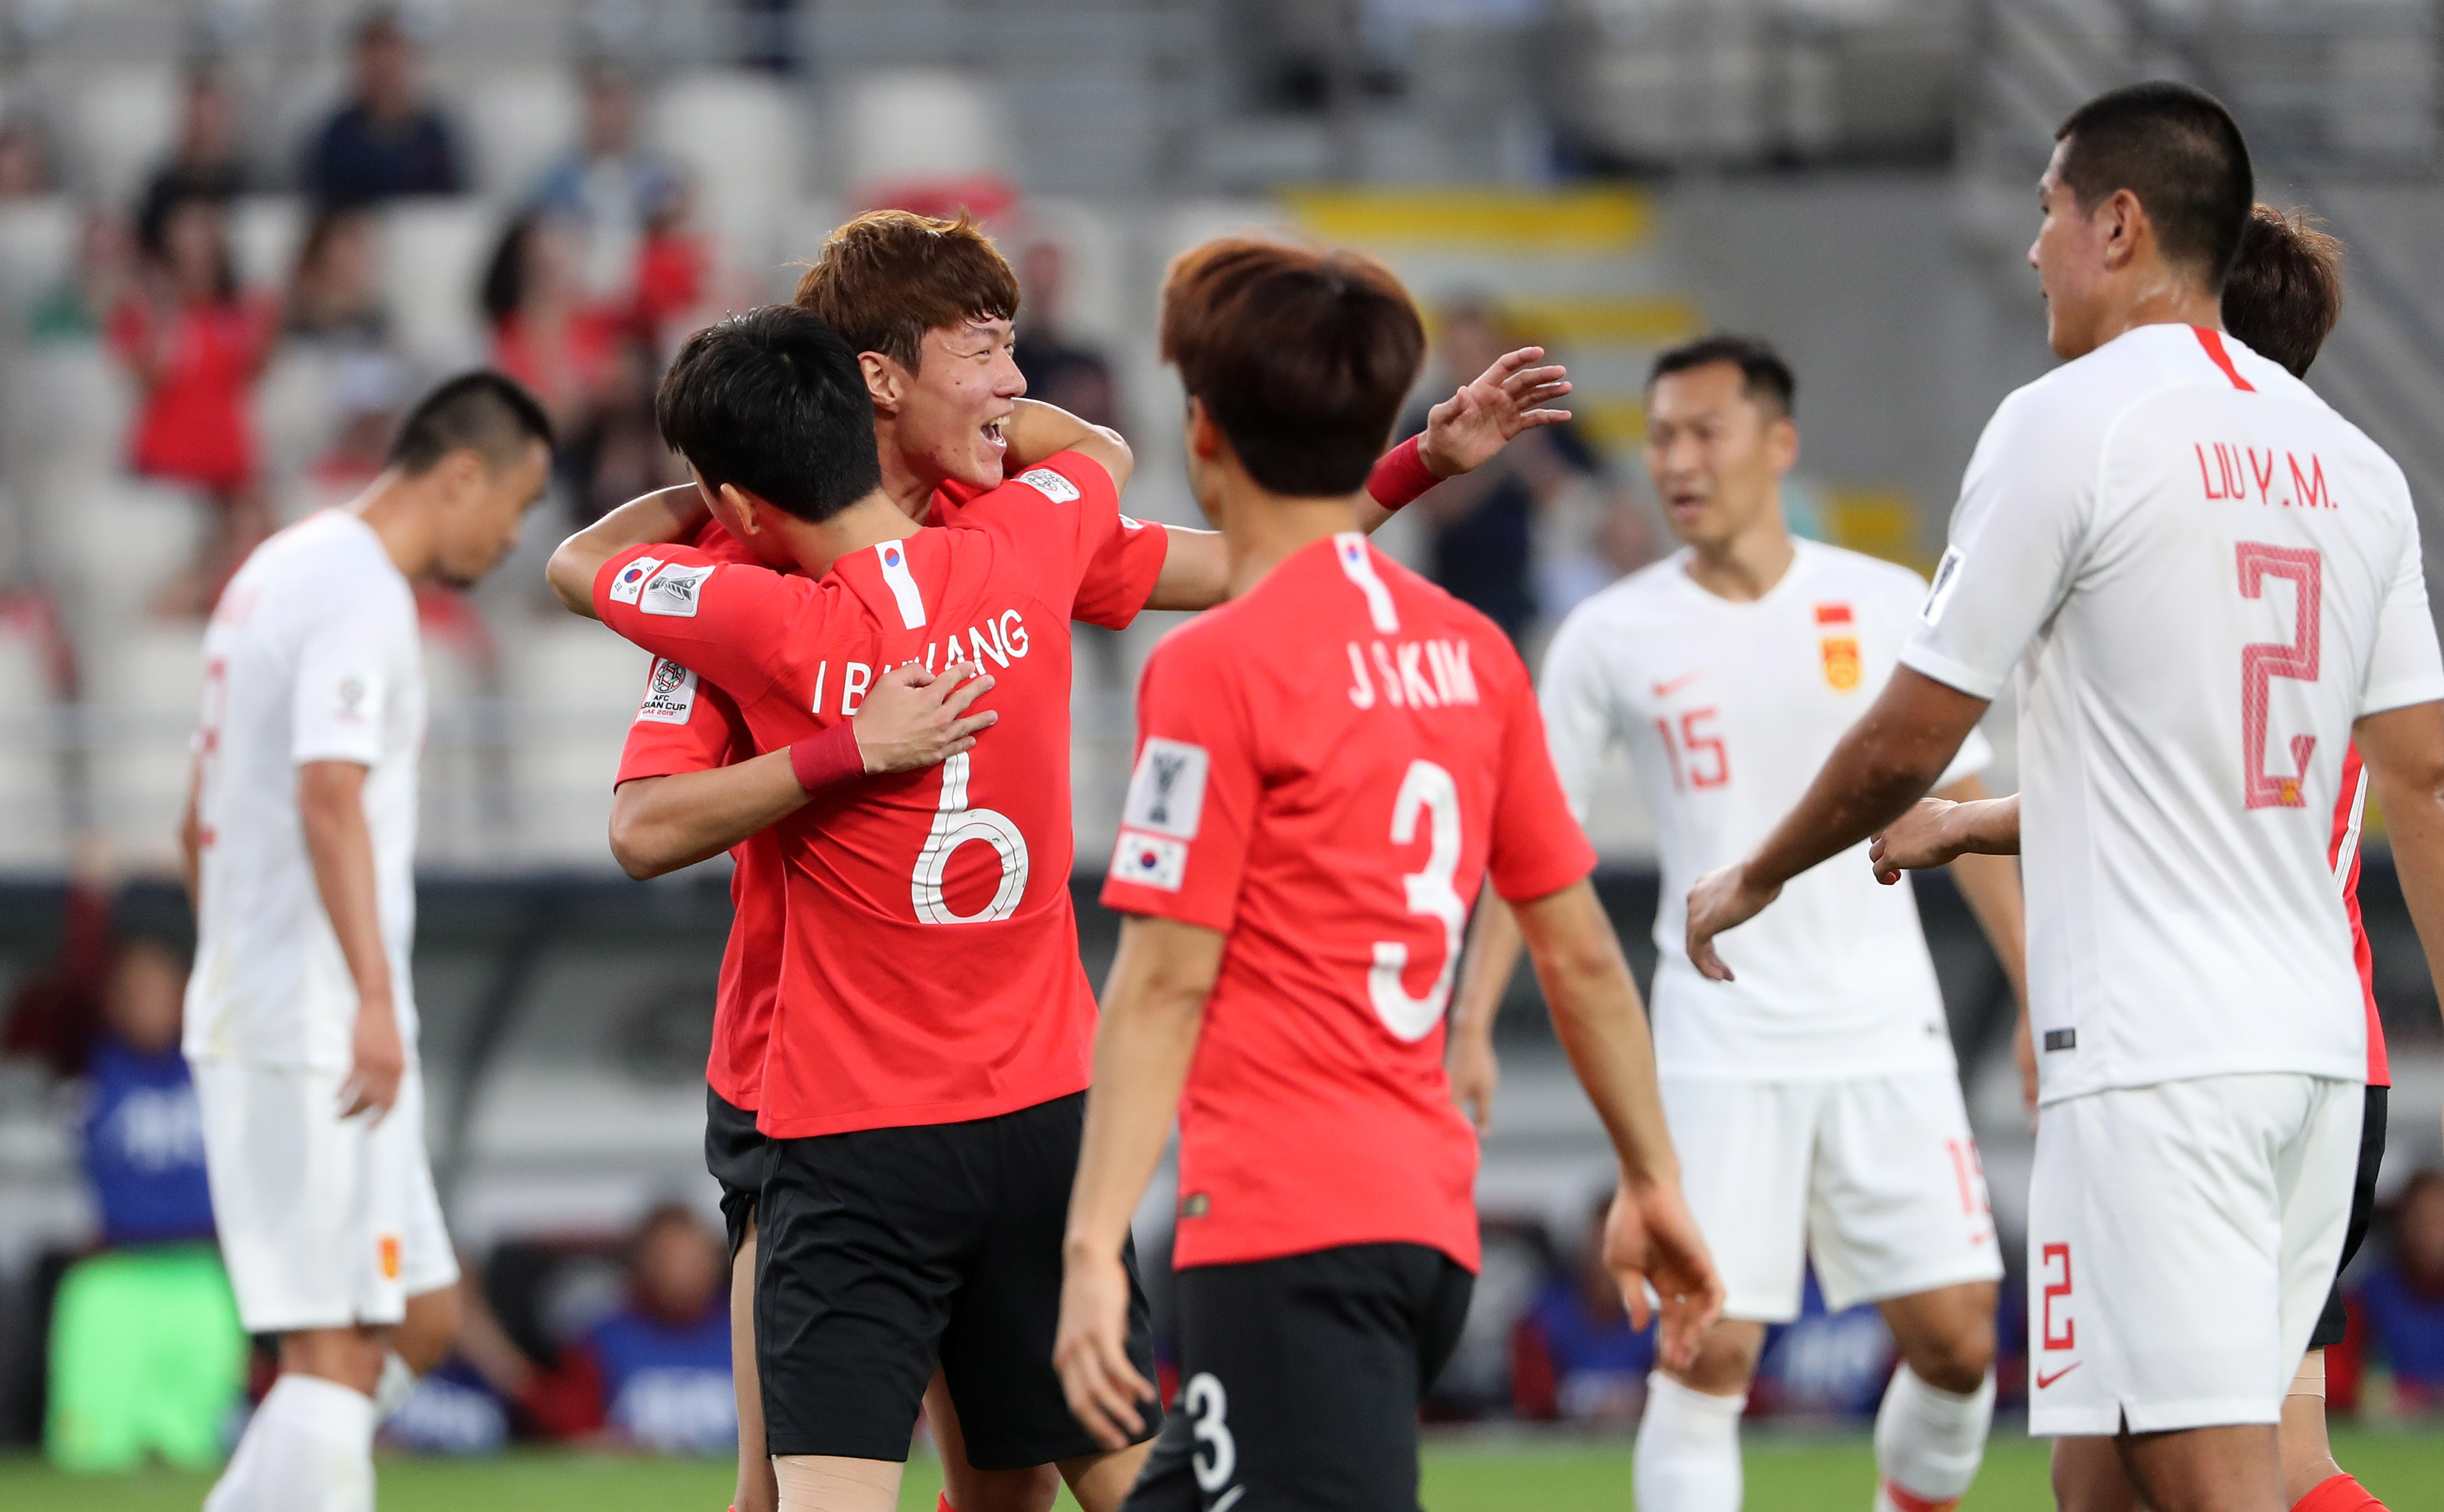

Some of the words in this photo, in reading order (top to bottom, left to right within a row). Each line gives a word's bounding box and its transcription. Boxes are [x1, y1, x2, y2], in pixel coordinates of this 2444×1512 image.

[2194, 442, 2245, 500] LIU
[2247, 447, 2338, 508] Y.M.
[665, 703, 686, 711] CUP
[2235, 541, 2321, 811] 2
[1655, 706, 1730, 794] 15
[911, 750, 1030, 925] 6
[1366, 759, 1466, 1044] 3
[2043, 1242, 2075, 1351] 2
[1186, 1370, 1237, 1494] 3
